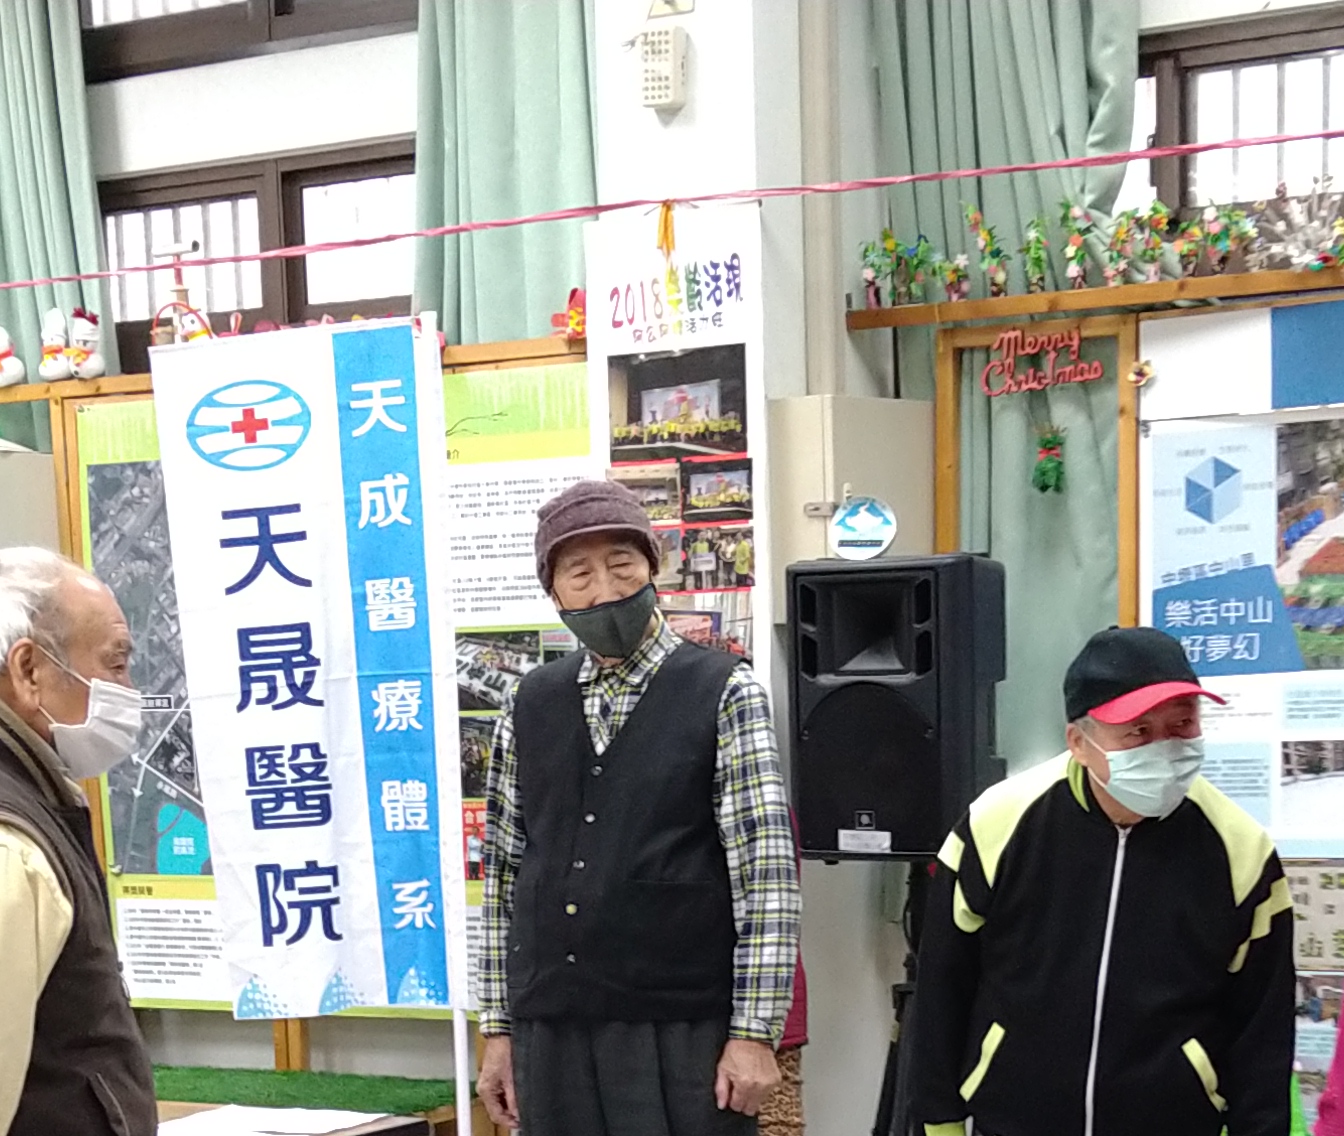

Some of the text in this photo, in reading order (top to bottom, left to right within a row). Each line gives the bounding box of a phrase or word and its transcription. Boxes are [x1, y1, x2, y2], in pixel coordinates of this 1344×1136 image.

[993, 328, 1081, 360] Merry
[1165, 596, 1273, 628] 樂活中山
[350, 379, 437, 930] 天成醫療體系
[1181, 633, 1260, 663] 好夢幻
[220, 503, 343, 947] 天晟醫院
